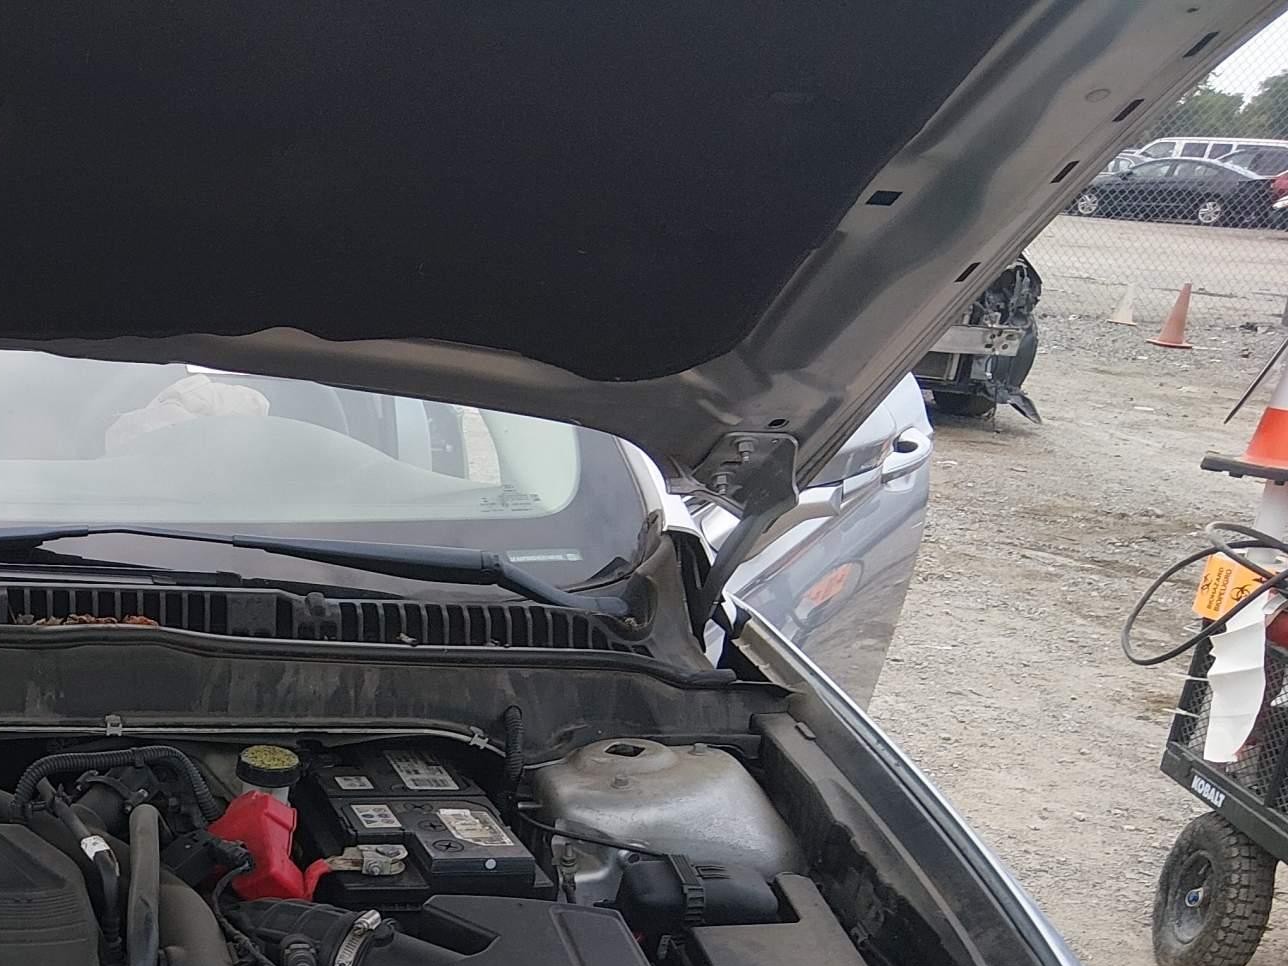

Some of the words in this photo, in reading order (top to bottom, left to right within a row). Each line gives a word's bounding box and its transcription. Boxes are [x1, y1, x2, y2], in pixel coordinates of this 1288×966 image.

[1207, 567, 1224, 610] BIOHAZARD
[1214, 569, 1232, 611] BIOPELIGRO
[1192, 775, 1226, 808] KOBALT
